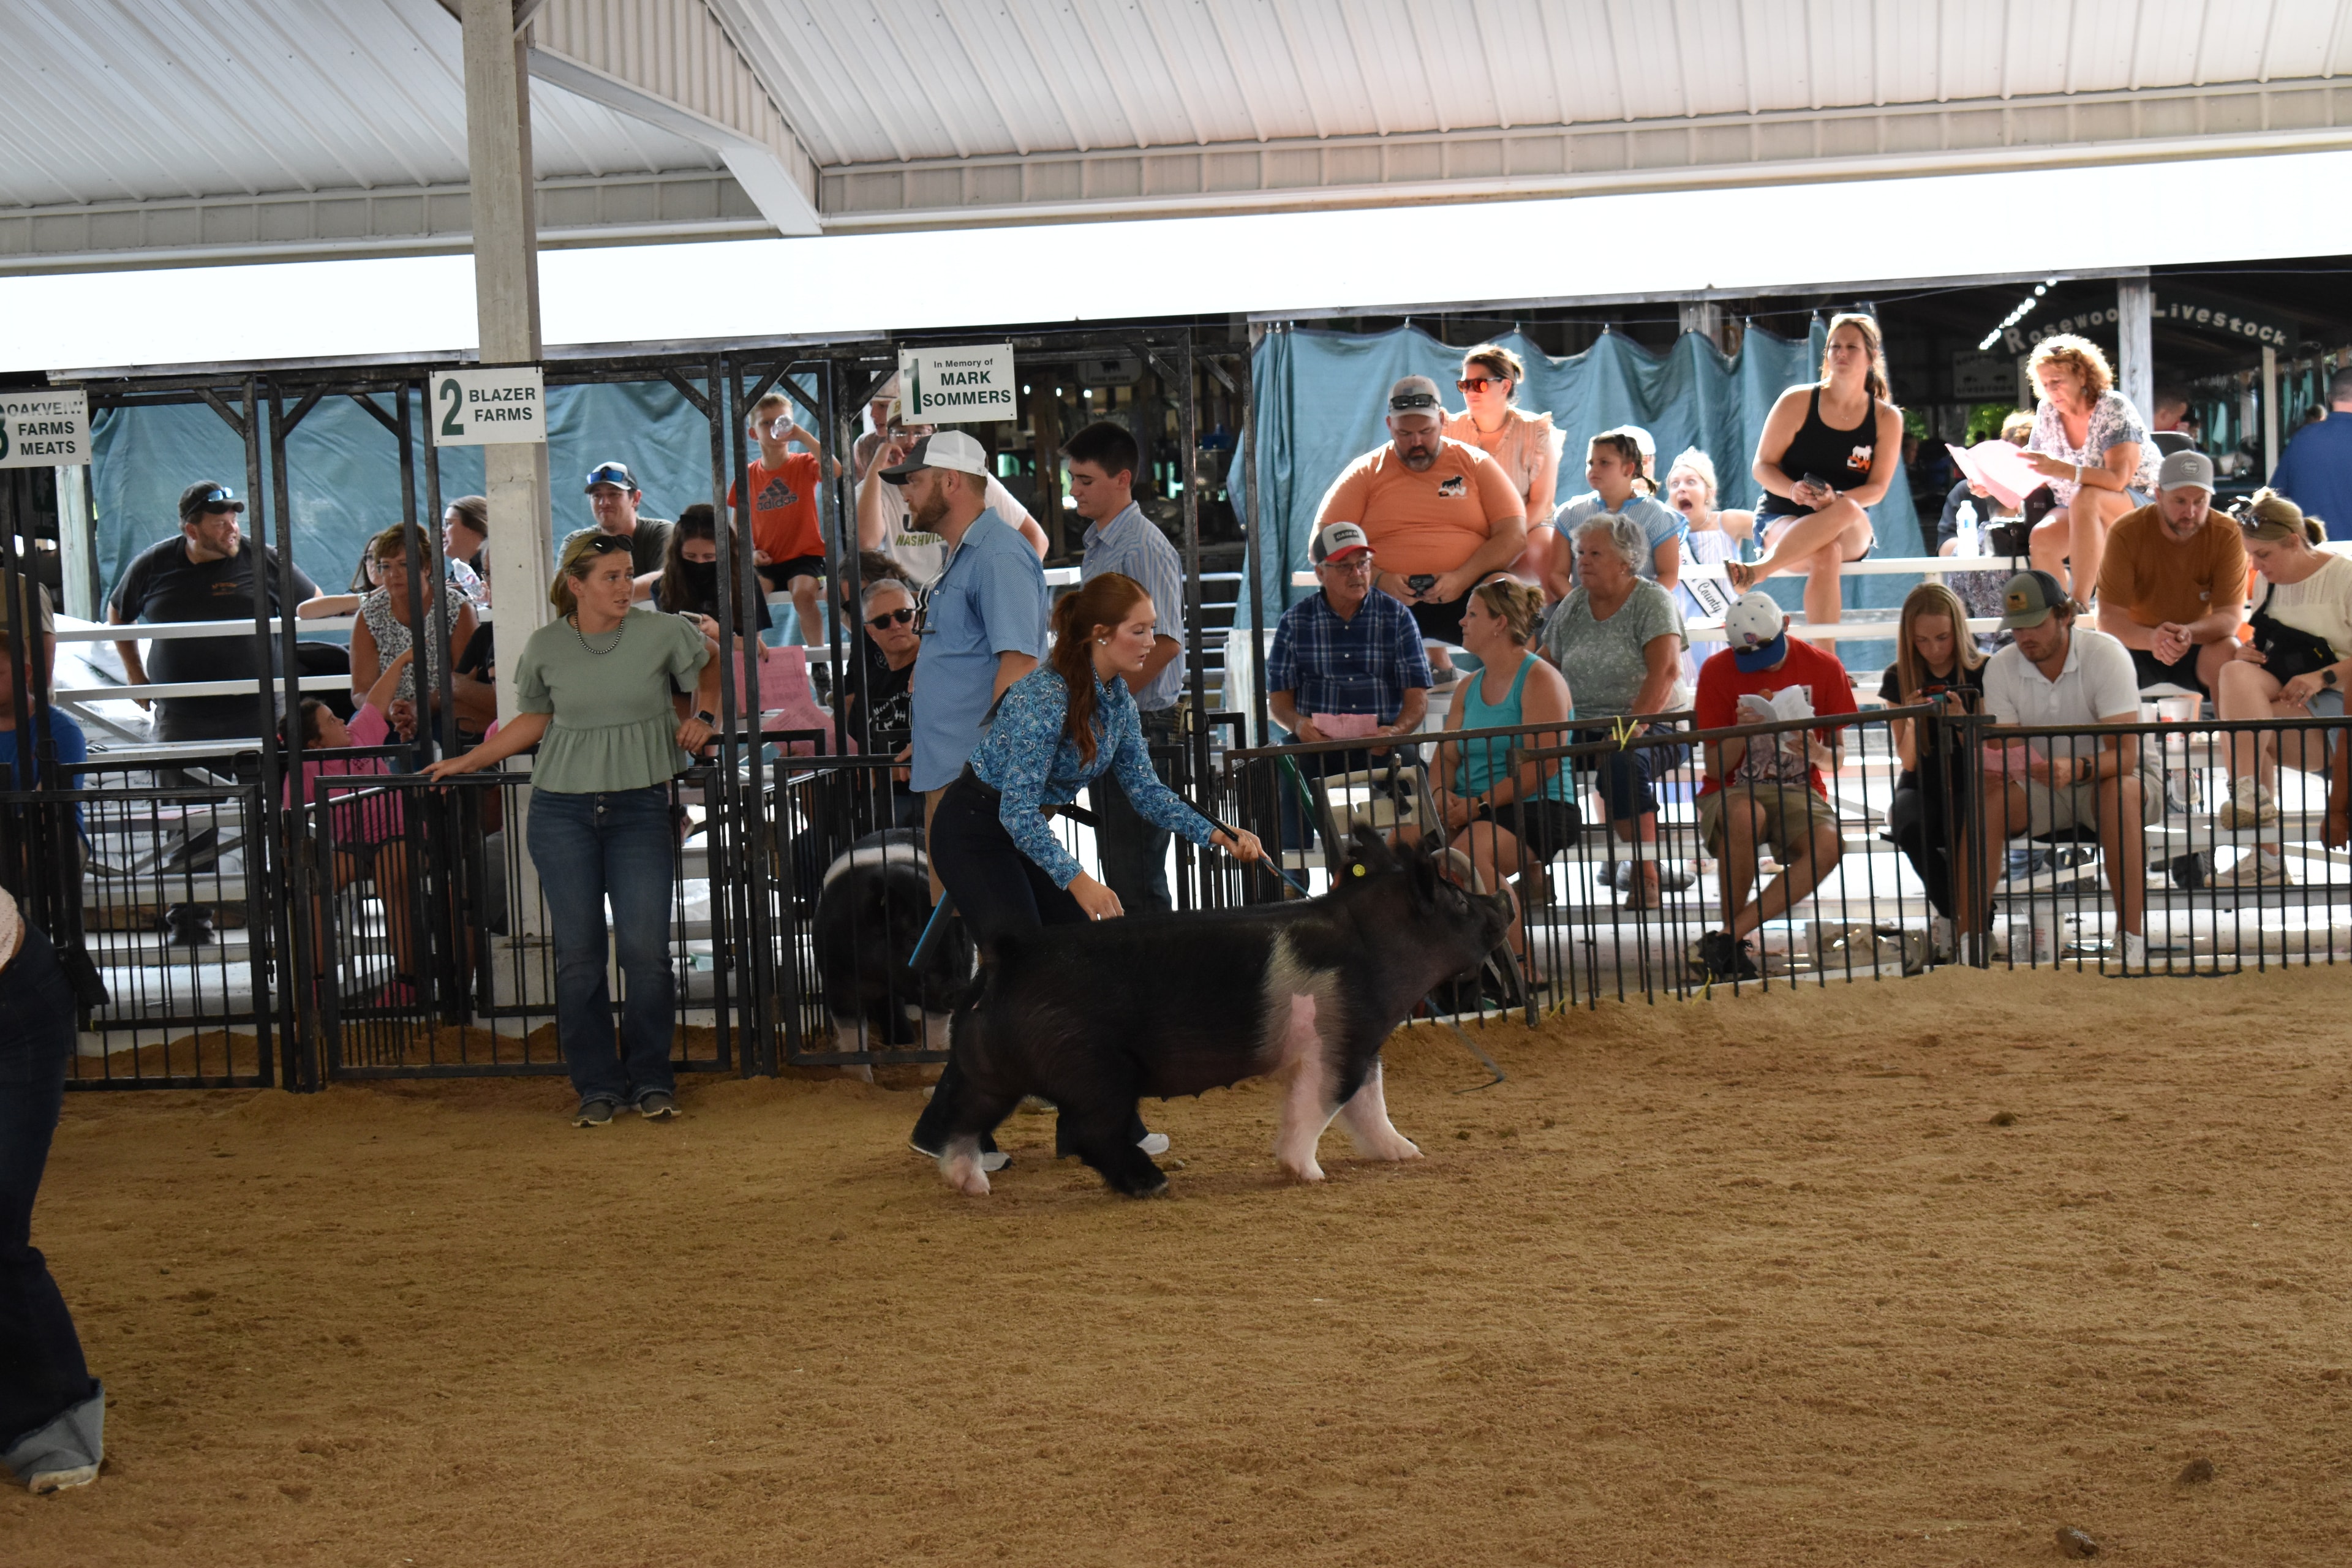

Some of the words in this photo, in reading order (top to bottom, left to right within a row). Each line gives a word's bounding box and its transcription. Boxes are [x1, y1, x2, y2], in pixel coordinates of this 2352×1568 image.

[2003, 308, 2119, 354] Rosewoo
[2149, 292, 2286, 346] Livestock
[946, 359, 981, 368] Memory
[904, 358, 922, 415] 1
[941, 371, 991, 386] MARK
[469, 388, 536, 402] BLAZER
[922, 390, 1011, 407] SOMMERS
[440, 379, 464, 436] 2
[475, 407, 532, 422] FARMS
[18, 421, 75, 436] FARMS
[20, 440, 75, 455] MEATS
[756, 494, 798, 511] adidas
[1697, 582, 1722, 614] County
